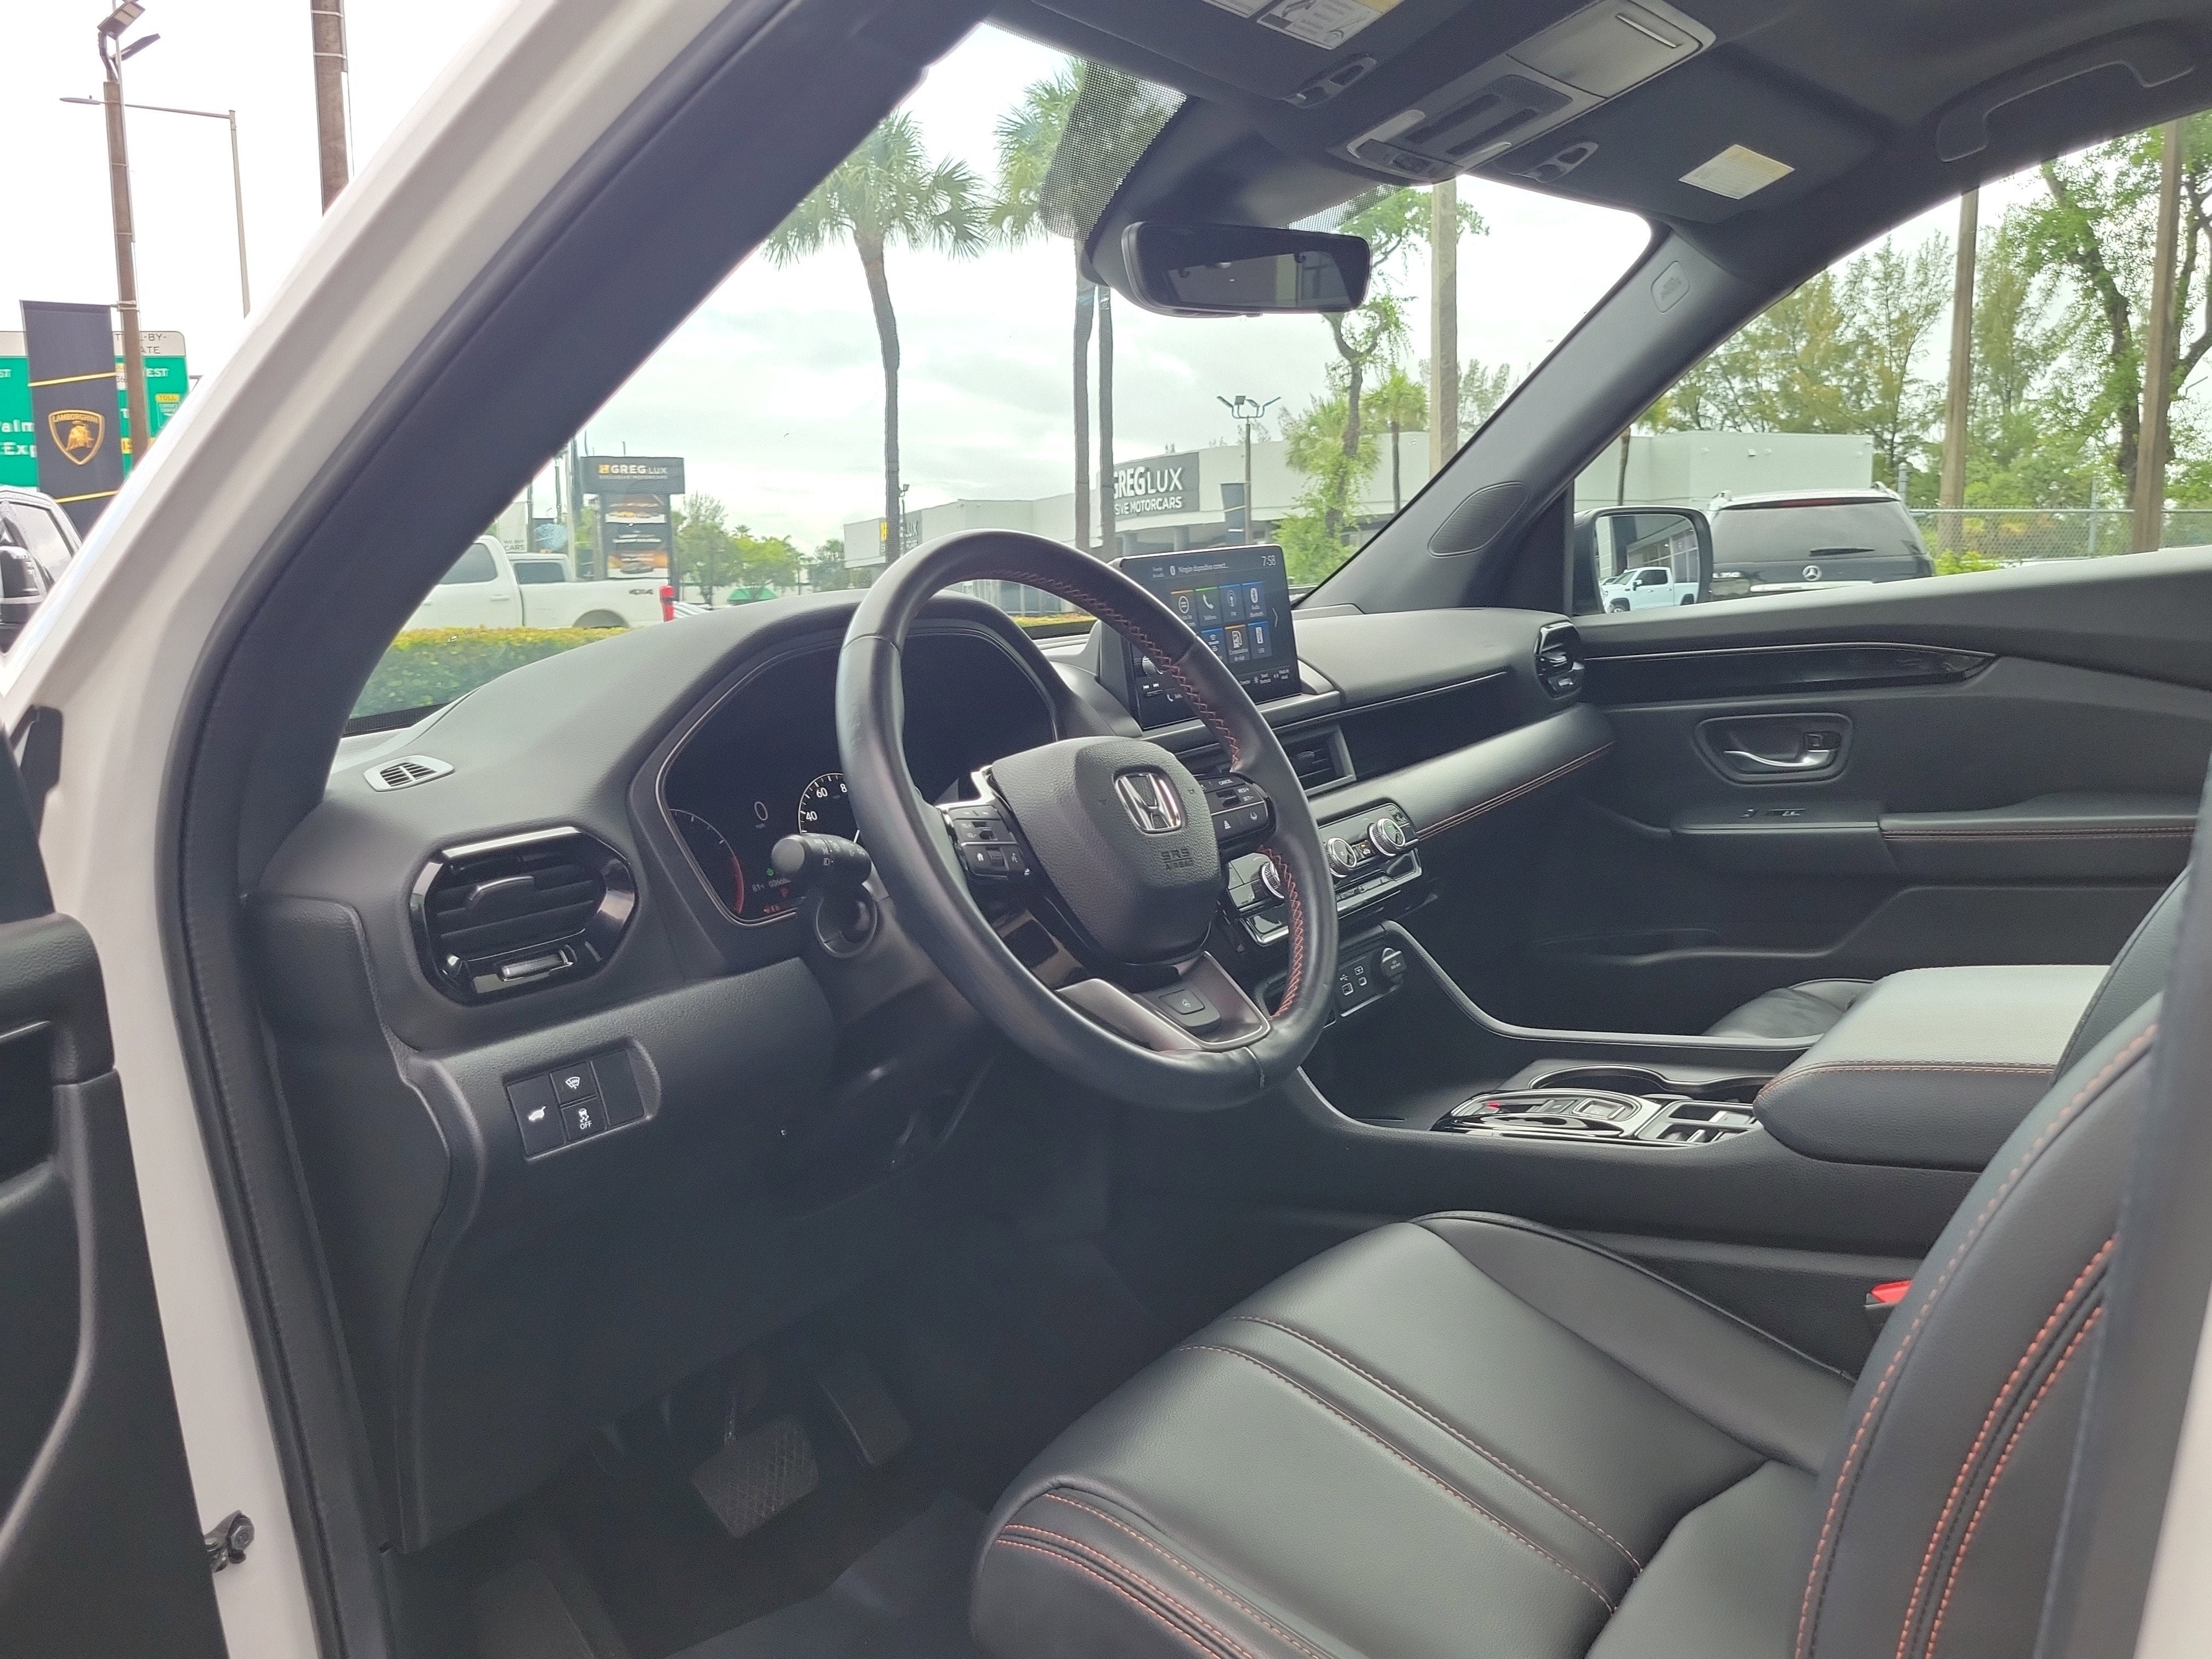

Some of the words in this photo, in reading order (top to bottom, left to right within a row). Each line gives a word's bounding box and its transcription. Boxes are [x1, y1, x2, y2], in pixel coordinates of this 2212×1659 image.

[0, 419, 35, 433] alm
[610, 464, 647, 475] GREG
[648, 466, 668, 475] LUX
[1147, 467, 1183, 494] LUX
[1130, 496, 1183, 514] MOTORCARS
[816, 787, 828, 798] 60
[806, 811, 818, 821] 40
[1161, 848, 1189, 861] SRS
[580, 1120, 592, 1129] OFF
